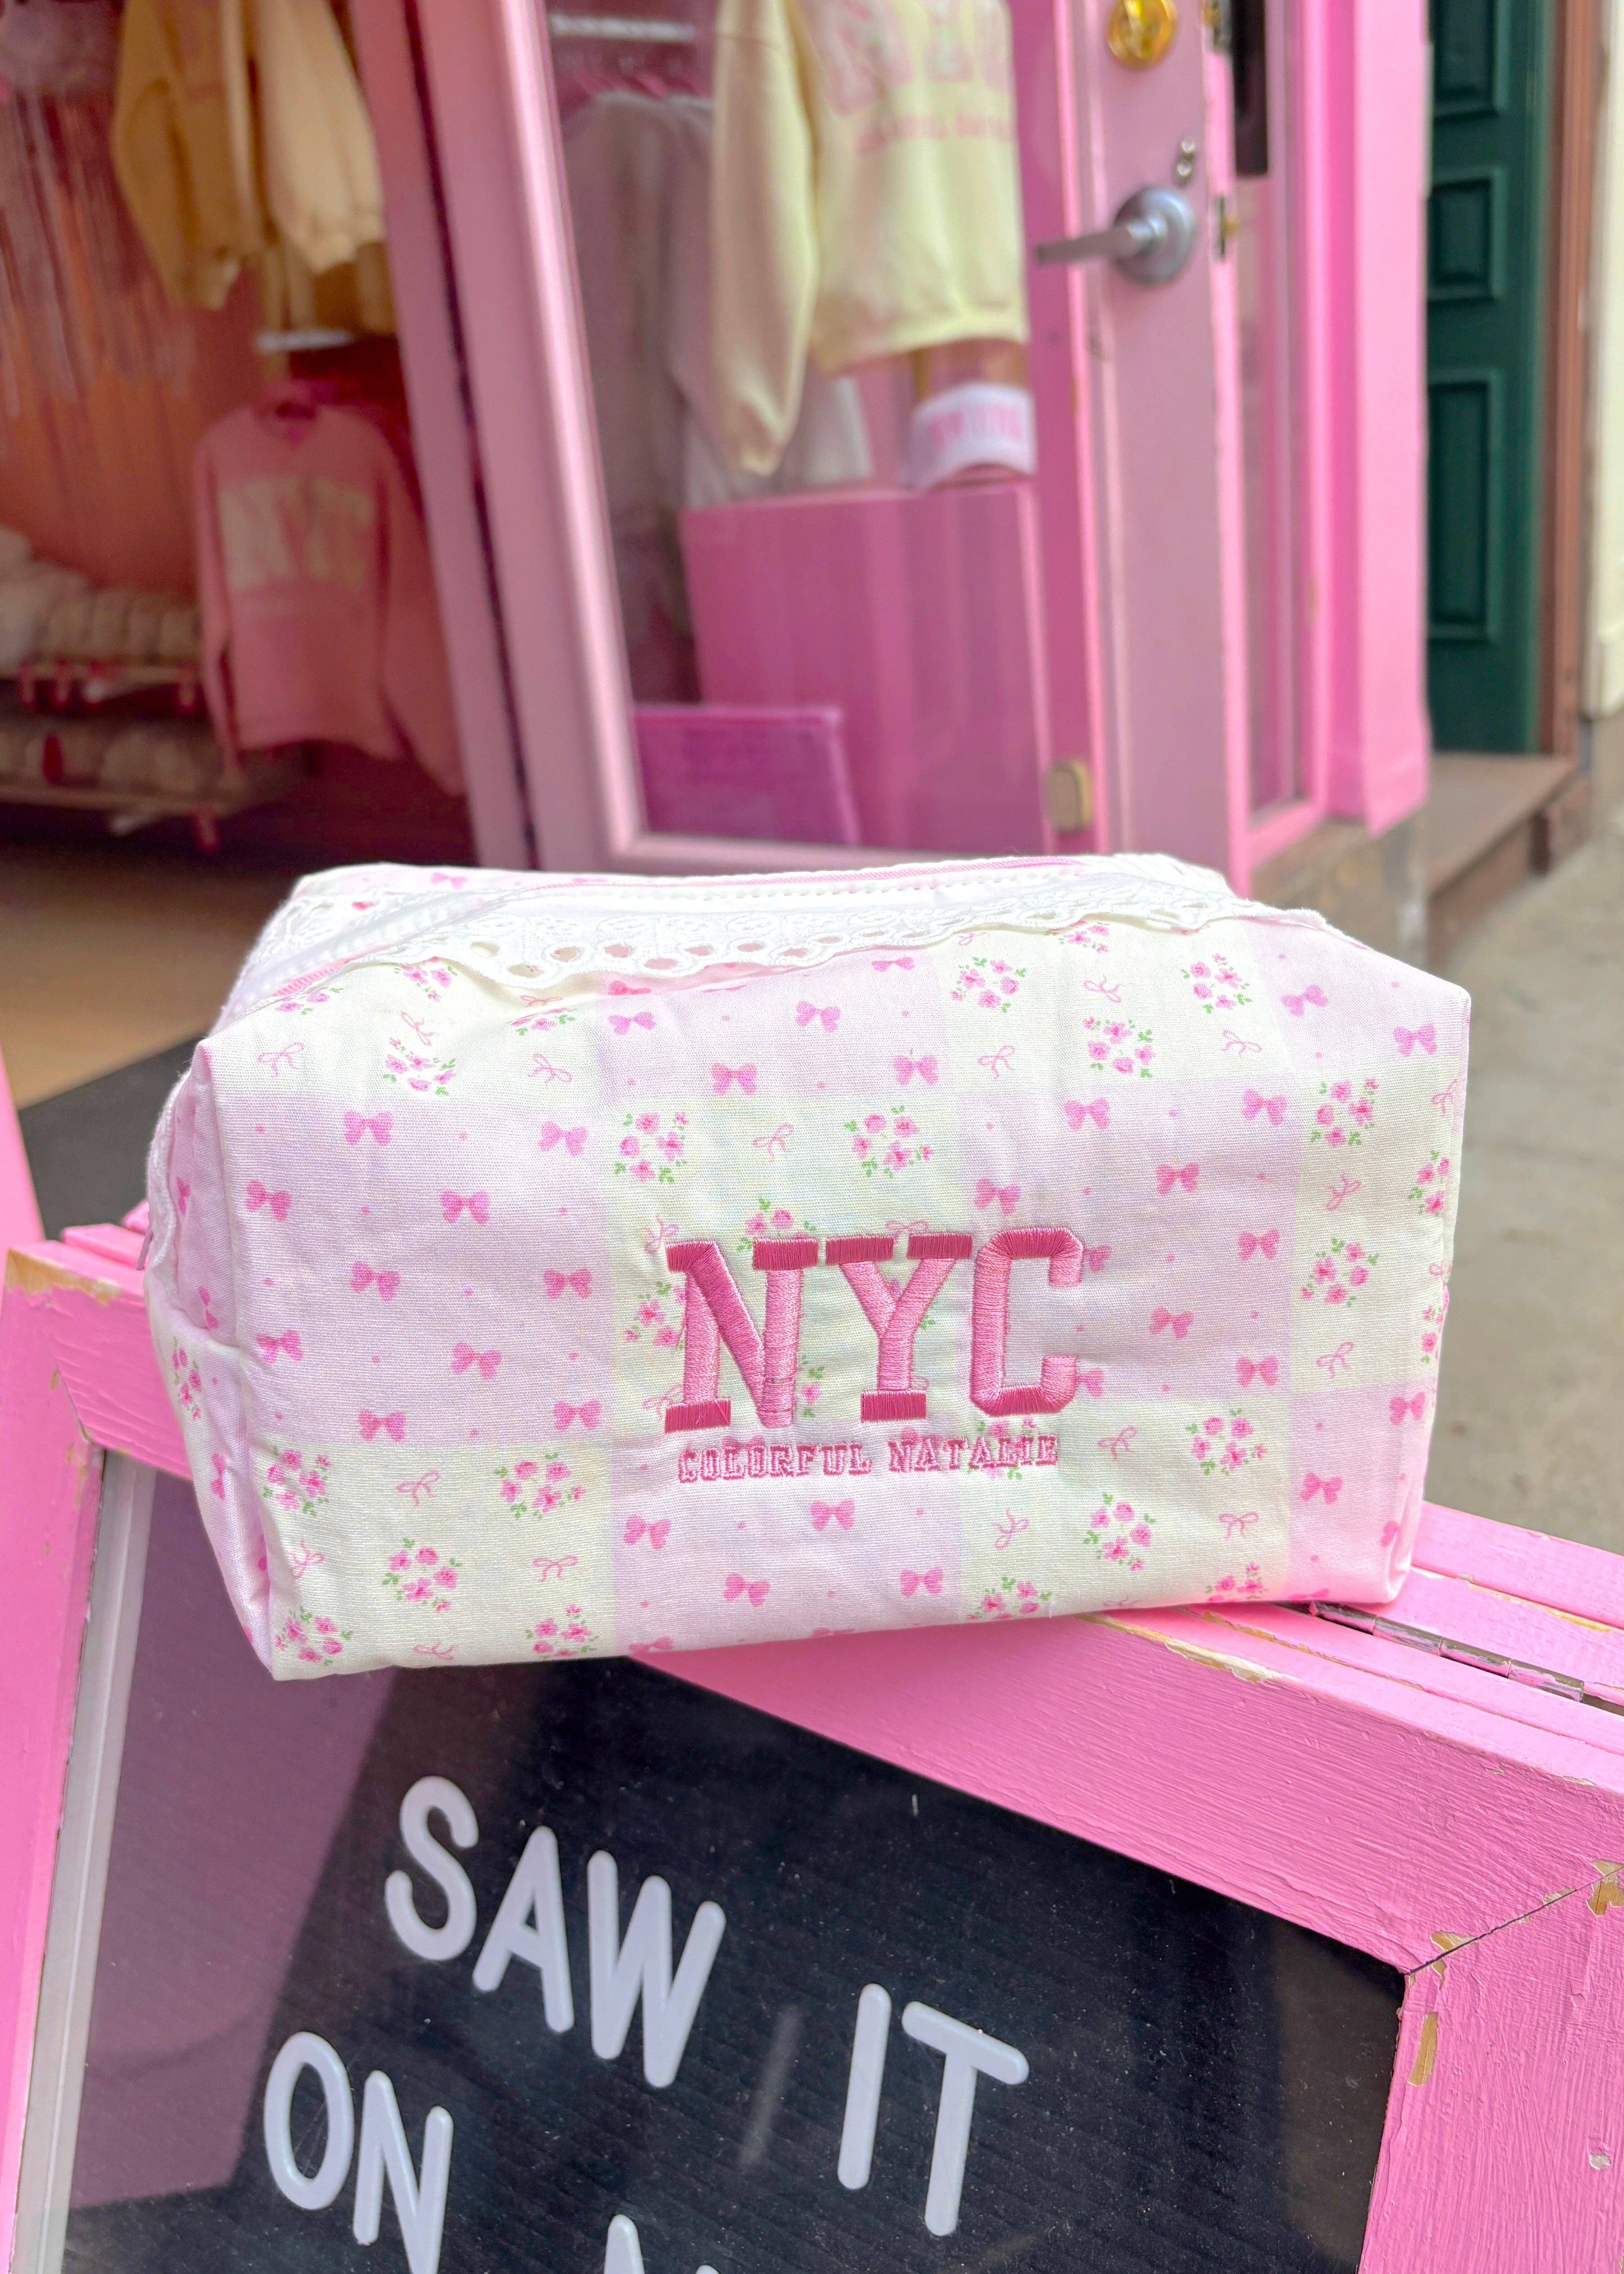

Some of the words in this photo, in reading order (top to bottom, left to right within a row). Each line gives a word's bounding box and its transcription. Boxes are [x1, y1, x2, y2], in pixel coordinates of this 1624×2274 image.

[665, 1228, 1083, 1433] NYC
[678, 1443, 872, 1483] COLORFUL
[888, 1434, 1058, 1473] NATALIE
[387, 1777, 725, 2087] SAW
[838, 1984, 1029, 2236] IT
[264, 2032, 453, 2274] ON
